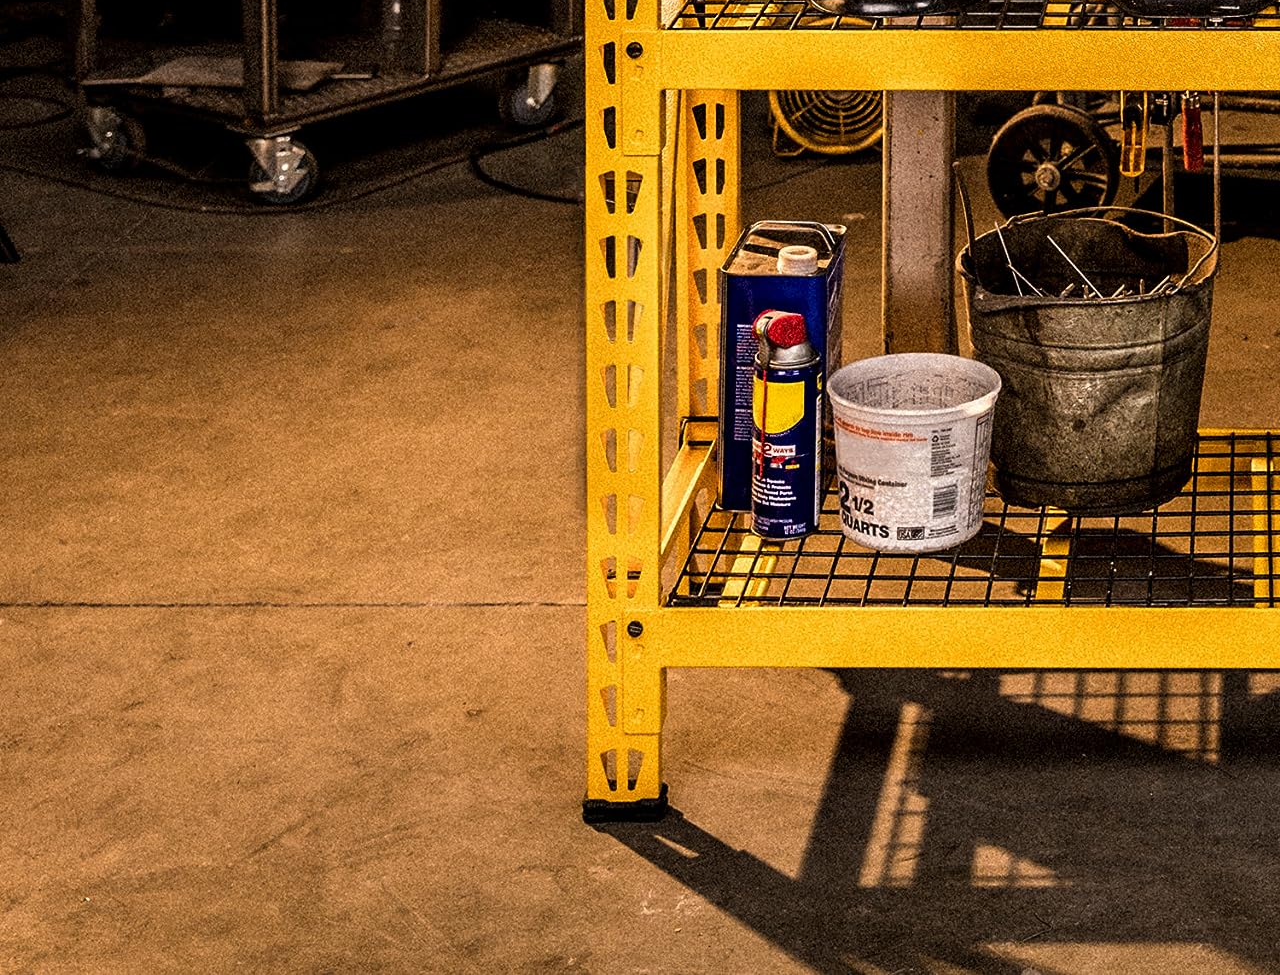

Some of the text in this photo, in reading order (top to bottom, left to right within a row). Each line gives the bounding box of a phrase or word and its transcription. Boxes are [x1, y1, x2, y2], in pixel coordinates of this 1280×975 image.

[882, 430, 902, 438] inside
[763, 443, 772, 457] 2
[858, 474, 877, 486] Mixing
[877, 479, 908, 488] Container
[839, 480, 874, 516] 2 1/2
